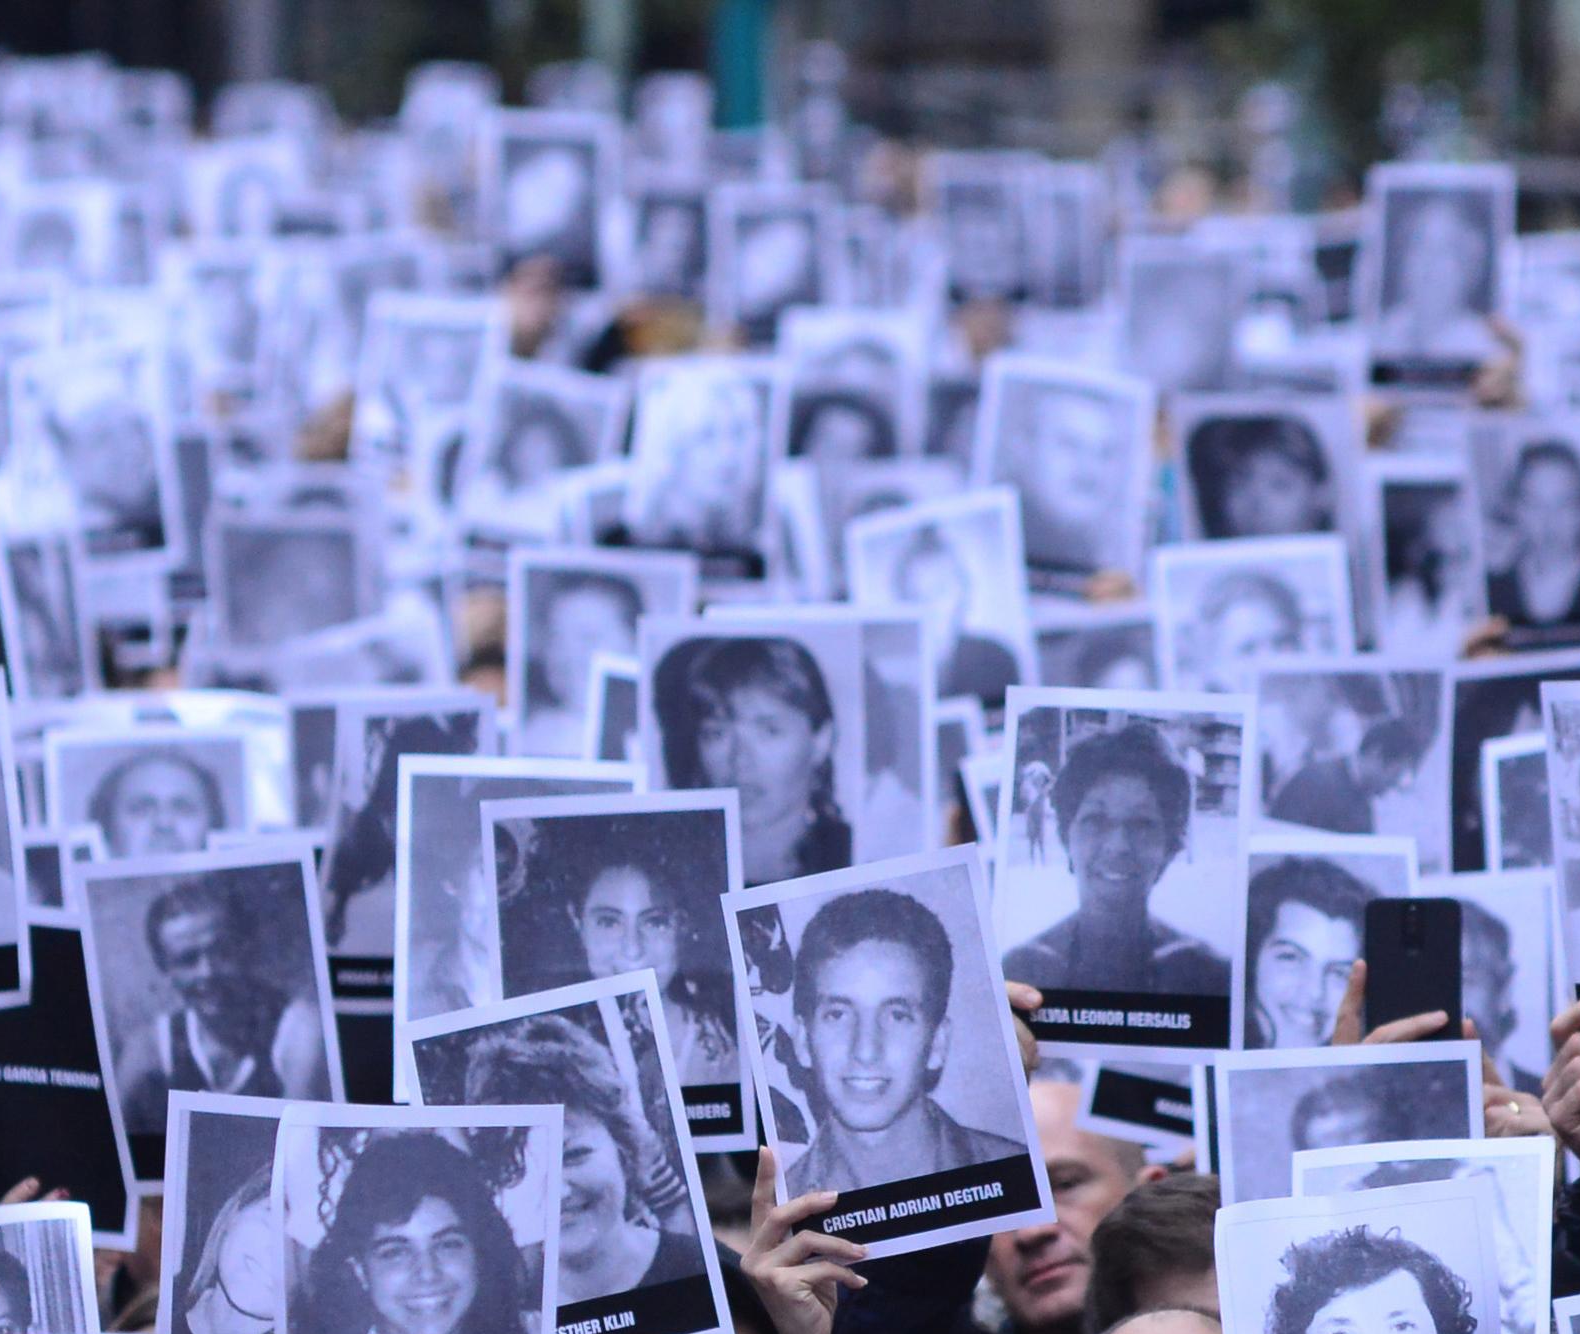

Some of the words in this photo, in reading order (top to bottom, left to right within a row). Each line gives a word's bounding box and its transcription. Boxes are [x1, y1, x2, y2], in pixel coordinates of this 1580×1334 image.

[1073, 1011, 1125, 1026] LEONOR
[1127, 1012, 1192, 1029] HERSALIS
[3, 1065, 48, 1085] GARCIA
[50, 1068, 101, 1089] TENORIO
[823, 1209, 889, 1234] CRISTIAN
[890, 1196, 942, 1221] ADRIAN
[944, 1182, 1005, 1210] DEGTIAR
[603, 1311, 636, 1332] KLIN
